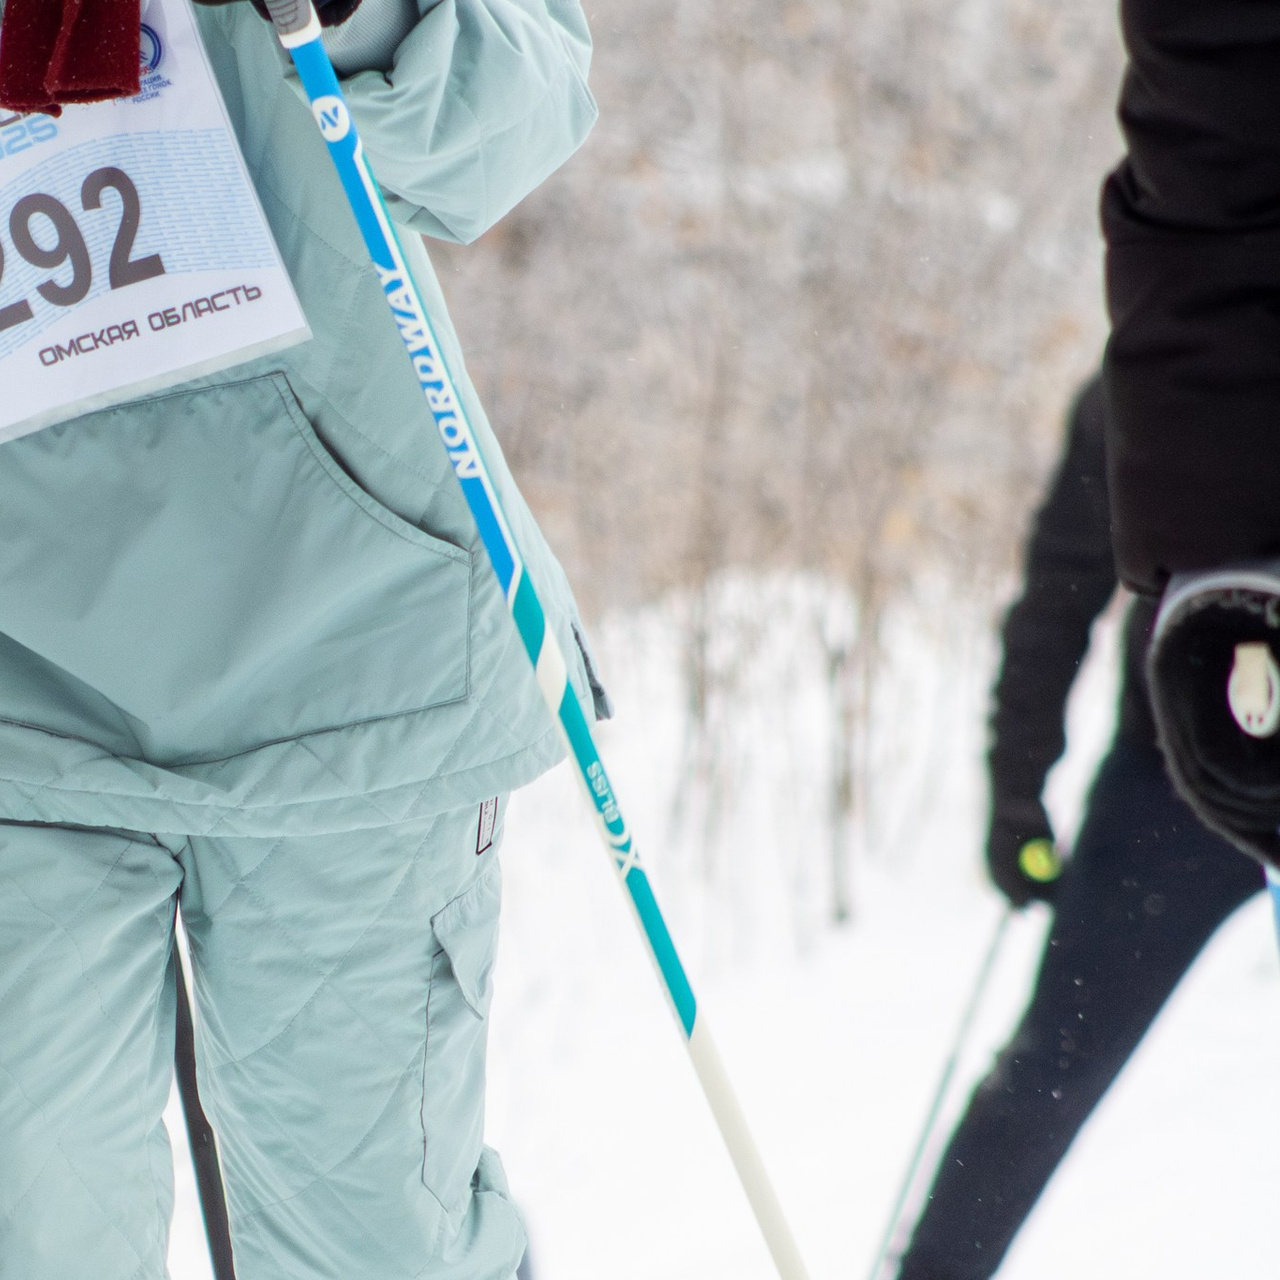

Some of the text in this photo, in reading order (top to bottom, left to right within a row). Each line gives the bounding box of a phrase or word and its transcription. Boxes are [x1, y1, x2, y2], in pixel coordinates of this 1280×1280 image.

[38, 283, 263, 368] ОМСКАЯ ОБЛАСТЬ
[372, 261, 482, 480] NORDWAY
